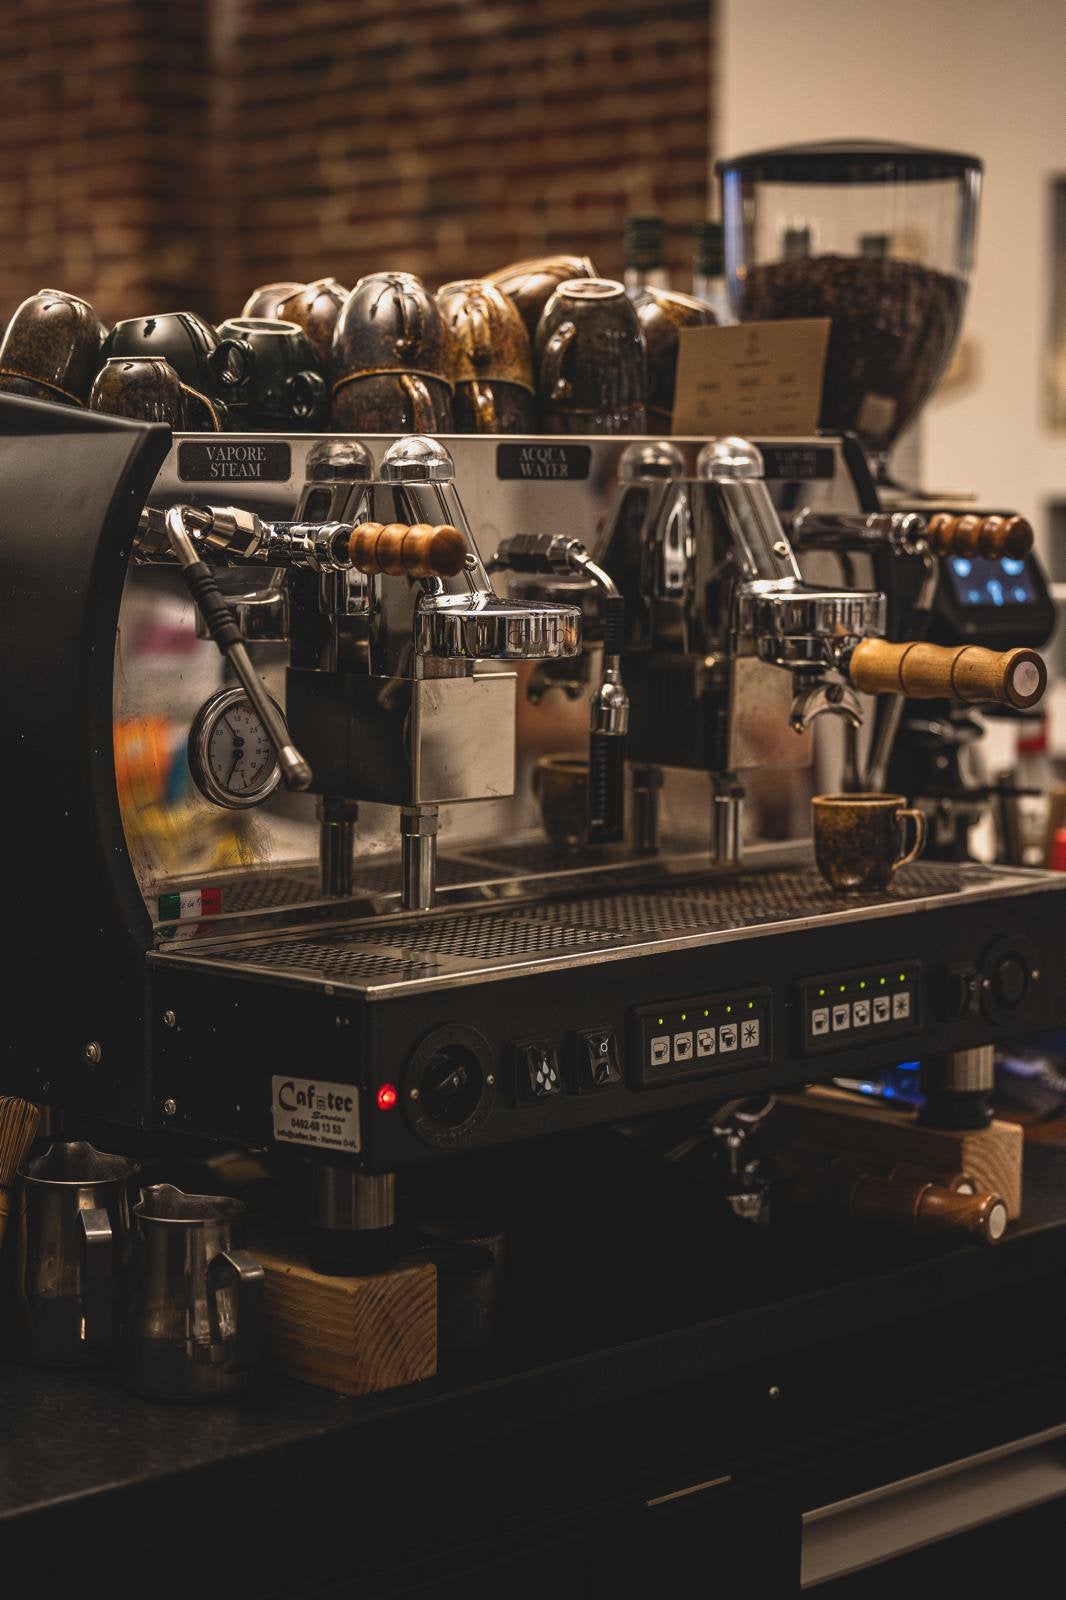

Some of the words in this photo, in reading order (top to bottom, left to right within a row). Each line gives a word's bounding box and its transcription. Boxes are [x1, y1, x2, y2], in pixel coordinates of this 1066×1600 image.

[206, 446, 267, 461] VAPORE
[519, 447, 566, 463] ACQUA
[210, 463, 262, 477] STEAM
[520, 463, 568, 477] WATER
[322, 1123, 331, 1134] 13
[332, 1124, 341, 1135] 53
